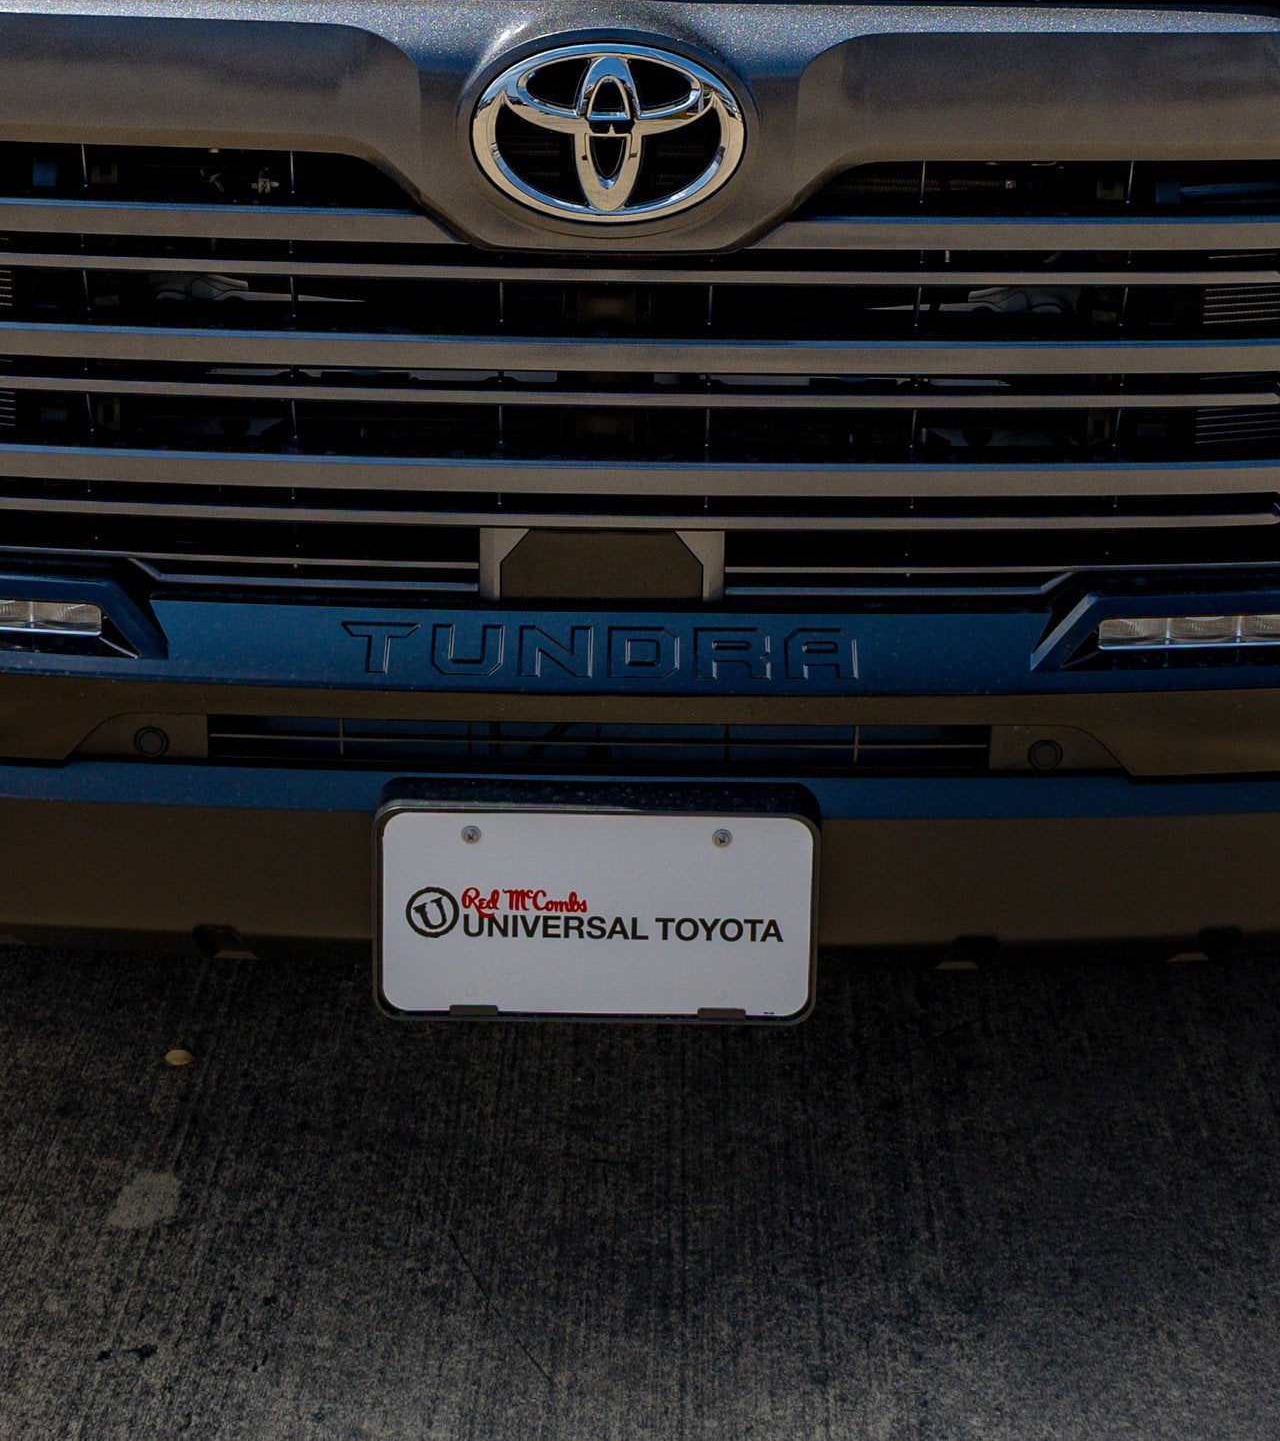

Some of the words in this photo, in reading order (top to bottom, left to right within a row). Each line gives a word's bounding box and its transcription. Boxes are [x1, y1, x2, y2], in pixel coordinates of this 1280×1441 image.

[341, 621, 859, 680] TUNDRA
[461, 887, 500, 919] Red
[463, 914, 649, 941] UNIVERSAL
[655, 917, 784, 943] TOYOTA
